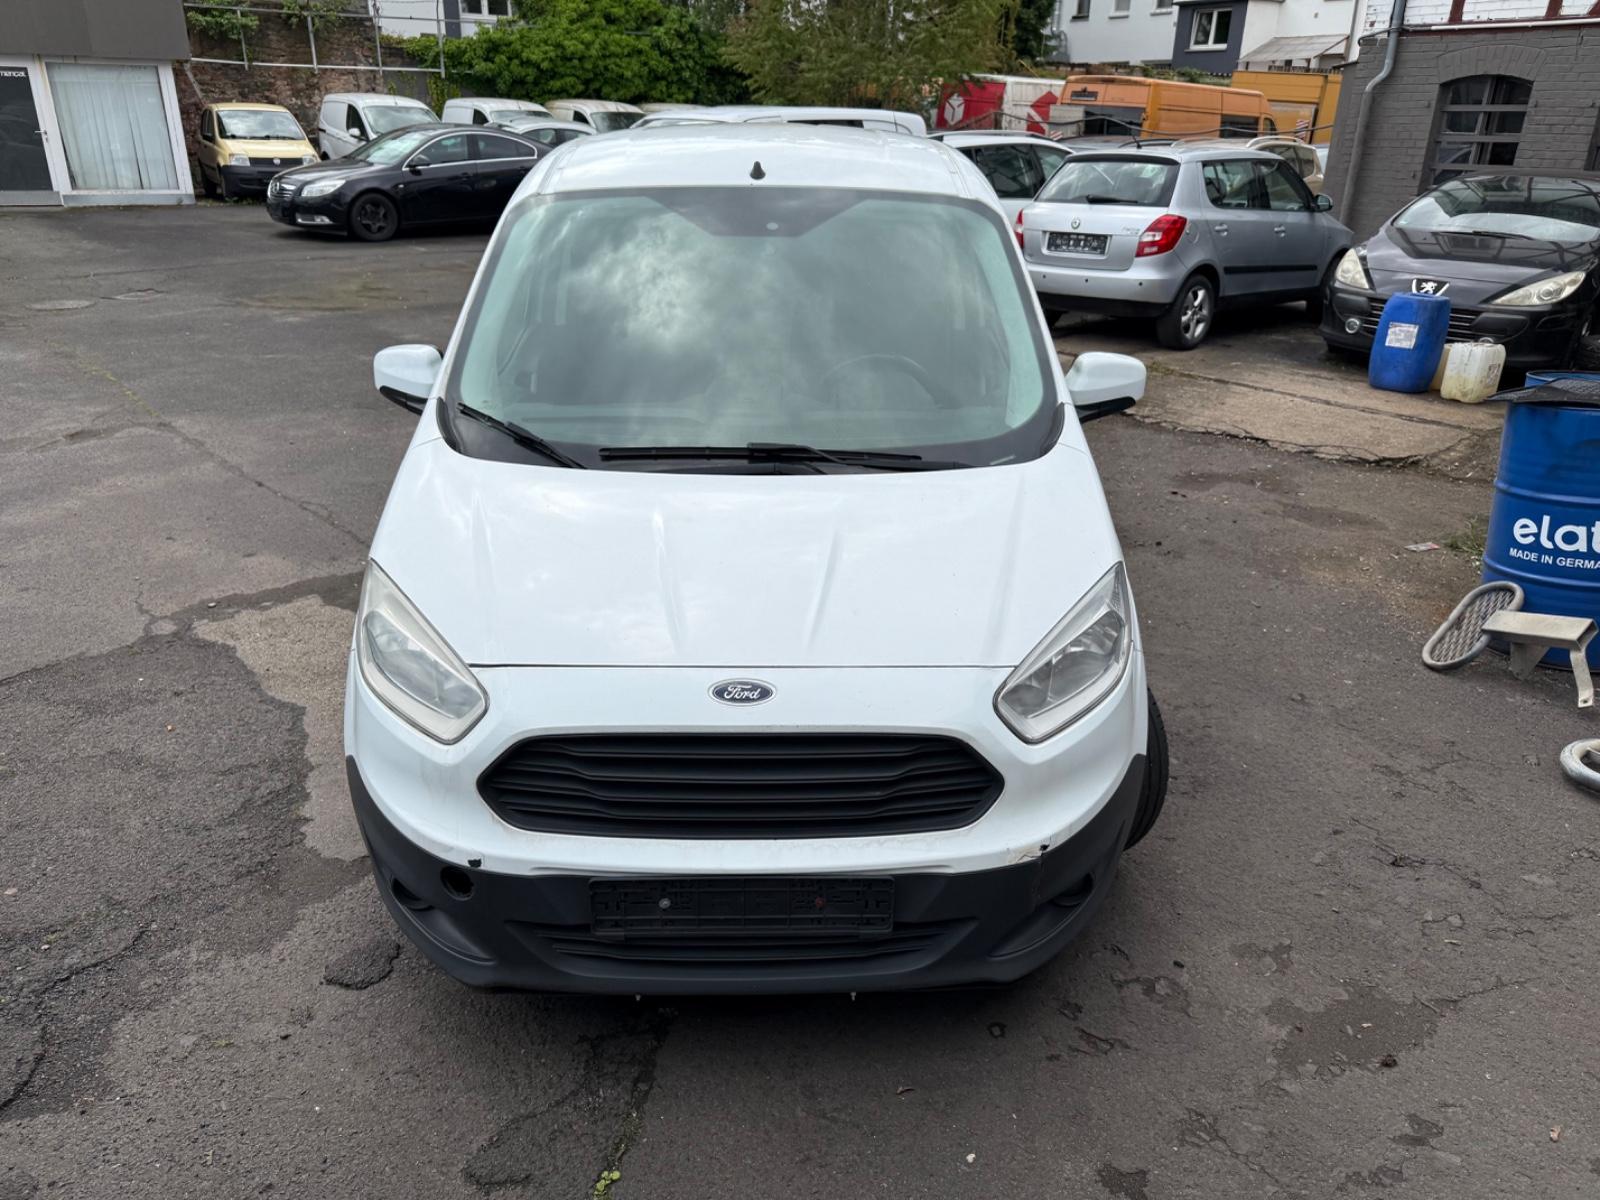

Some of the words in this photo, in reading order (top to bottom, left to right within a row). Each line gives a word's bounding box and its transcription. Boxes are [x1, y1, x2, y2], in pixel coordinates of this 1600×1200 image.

[1509, 547, 1538, 562] MADE
[1541, 554, 1553, 565] IN
[724, 685, 761, 699] Ford
